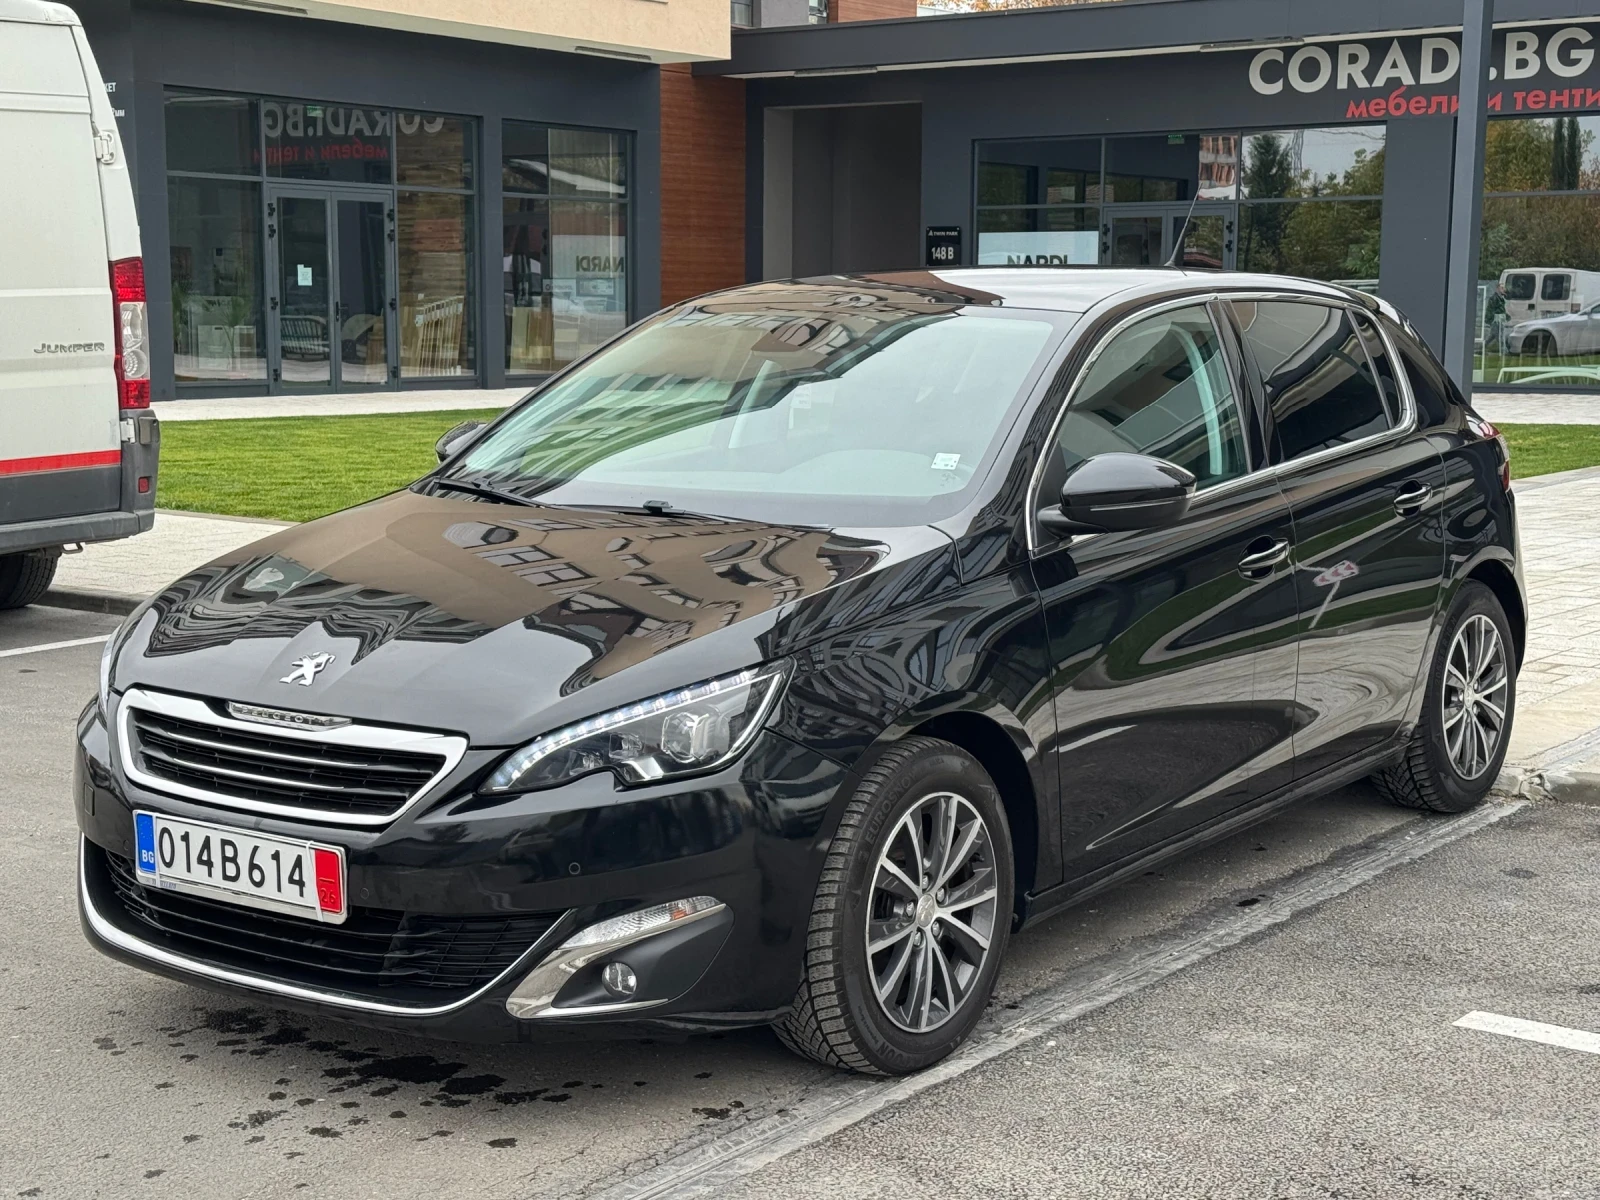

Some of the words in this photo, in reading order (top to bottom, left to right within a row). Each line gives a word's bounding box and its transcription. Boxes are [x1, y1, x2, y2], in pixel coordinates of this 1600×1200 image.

[1248, 27, 1595, 95] CORAD.BG
[931, 246, 946, 260] 148
[947, 246, 955, 260] B
[33, 342, 105, 354] JUMPER
[241, 705, 316, 725] PEUGEOT
[141, 849, 155, 865] BG
[158, 826, 306, 898] 014B614
[320, 889, 336, 905] 26
